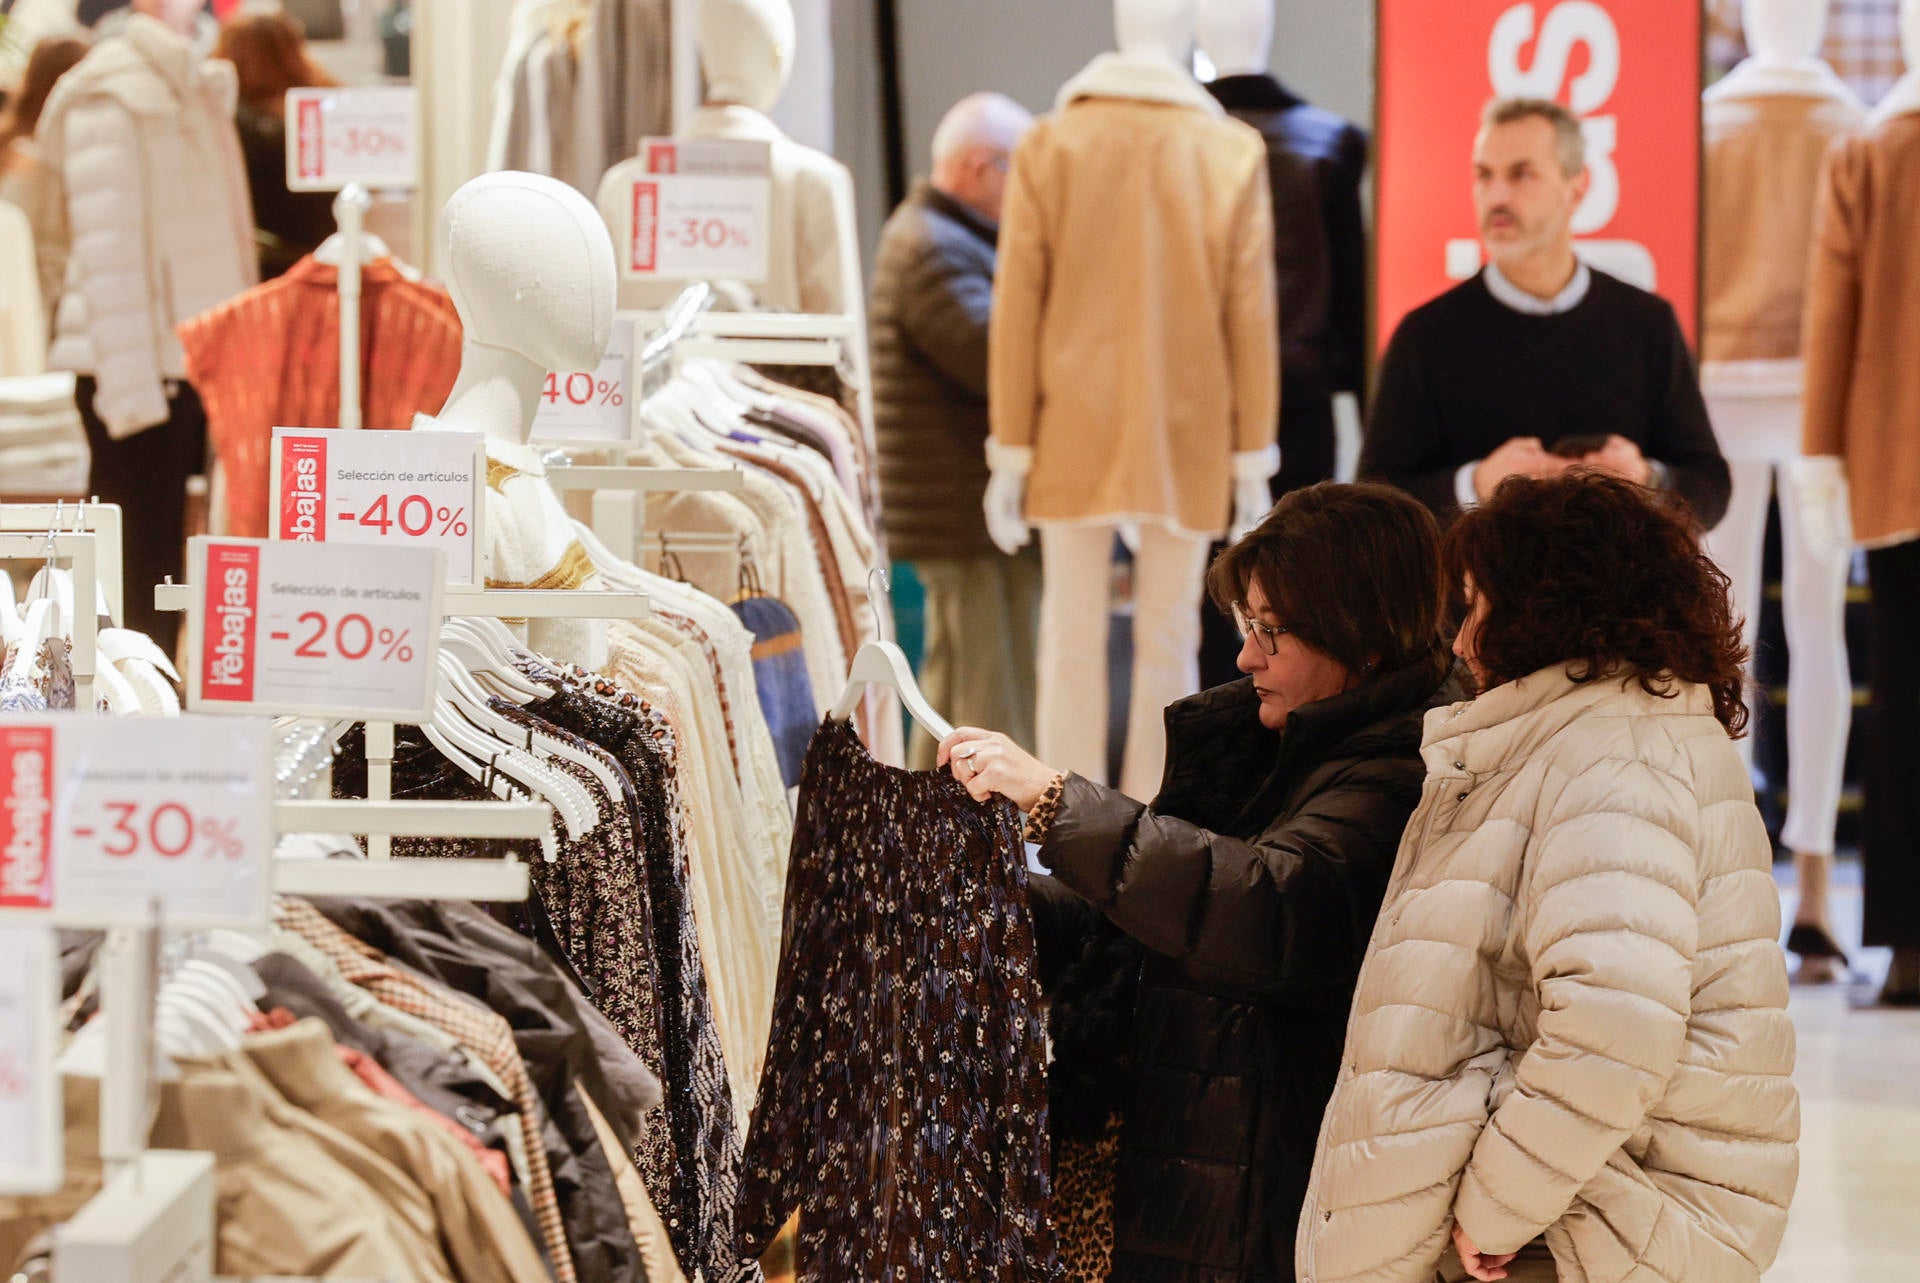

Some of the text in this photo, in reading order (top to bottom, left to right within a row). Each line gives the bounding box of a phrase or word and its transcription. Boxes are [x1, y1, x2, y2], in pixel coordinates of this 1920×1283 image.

[665, 217, 751, 250] -30%
[541, 372, 623, 406] 40%
[337, 469, 469, 482] Selección de artículos
[337, 494, 468, 537] -40%
[270, 582, 421, 601] Selección de artículos
[214, 567, 252, 687] rebajas
[270, 611, 413, 663] -20%
[73, 801, 245, 860] -30%
